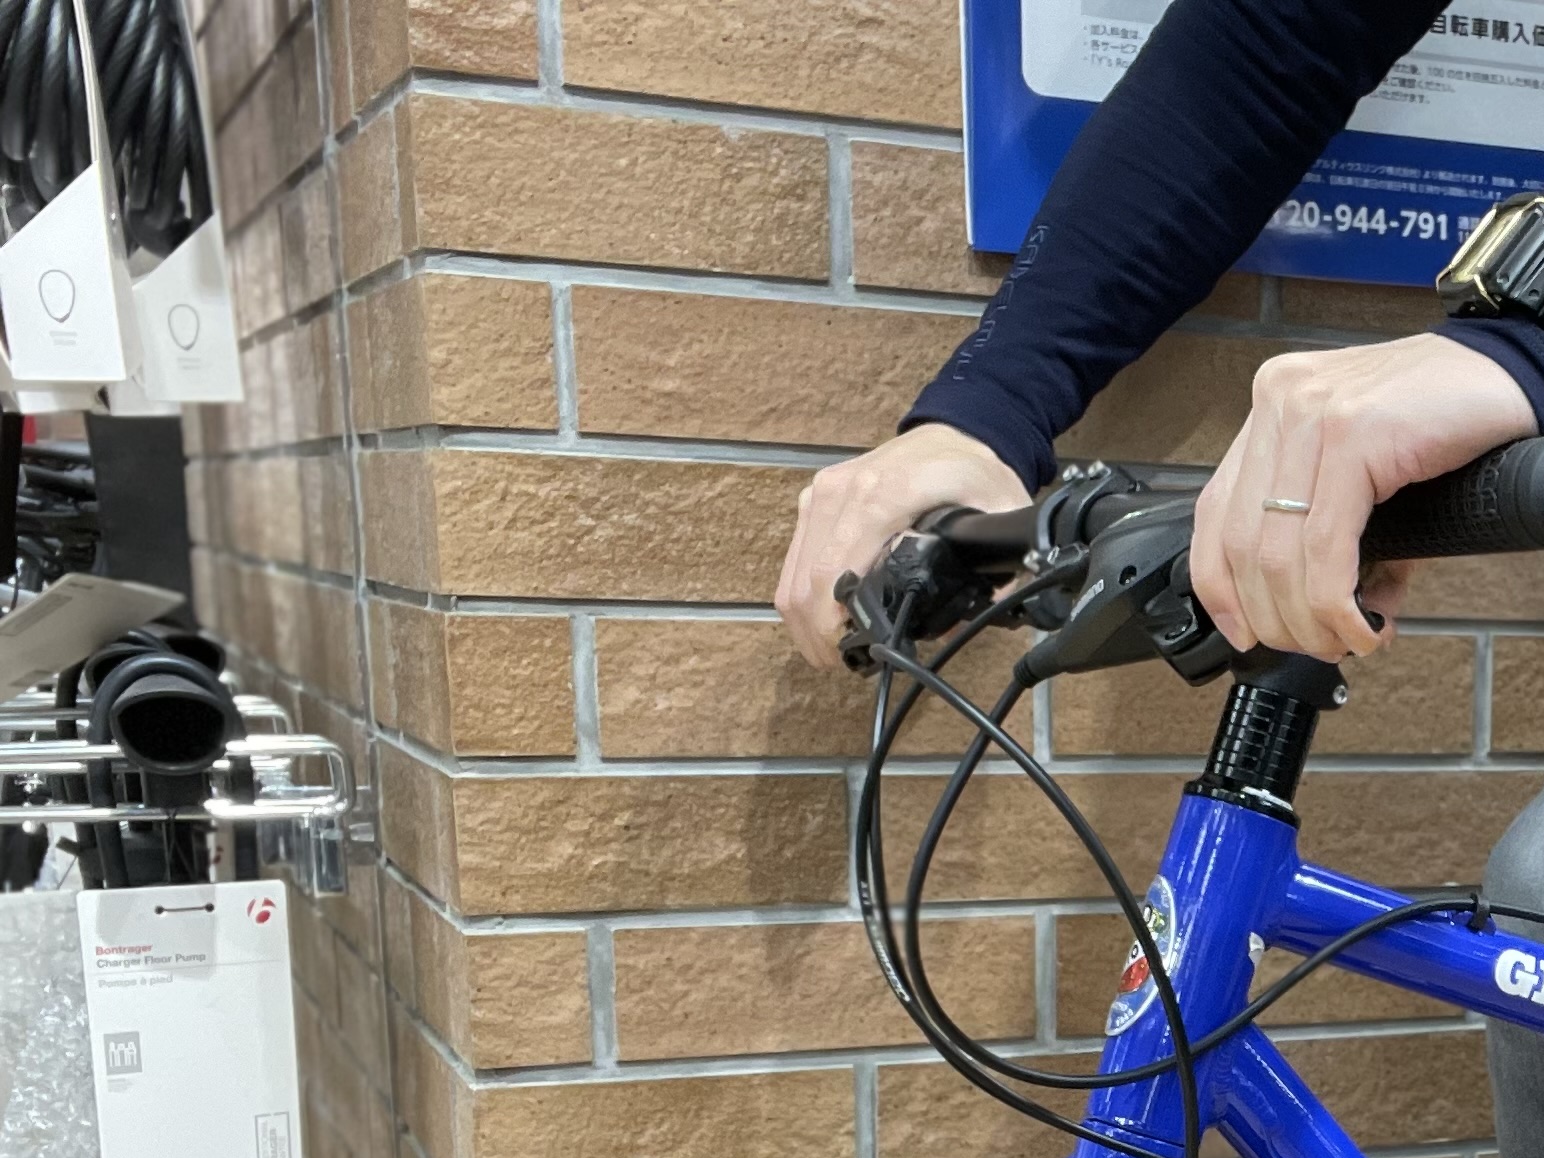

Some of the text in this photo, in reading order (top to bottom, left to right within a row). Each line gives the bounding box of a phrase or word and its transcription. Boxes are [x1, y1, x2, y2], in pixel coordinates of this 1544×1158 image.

[95, 942, 153, 956] Bontrager
[96, 953, 207, 969] Charger Floor Pump
